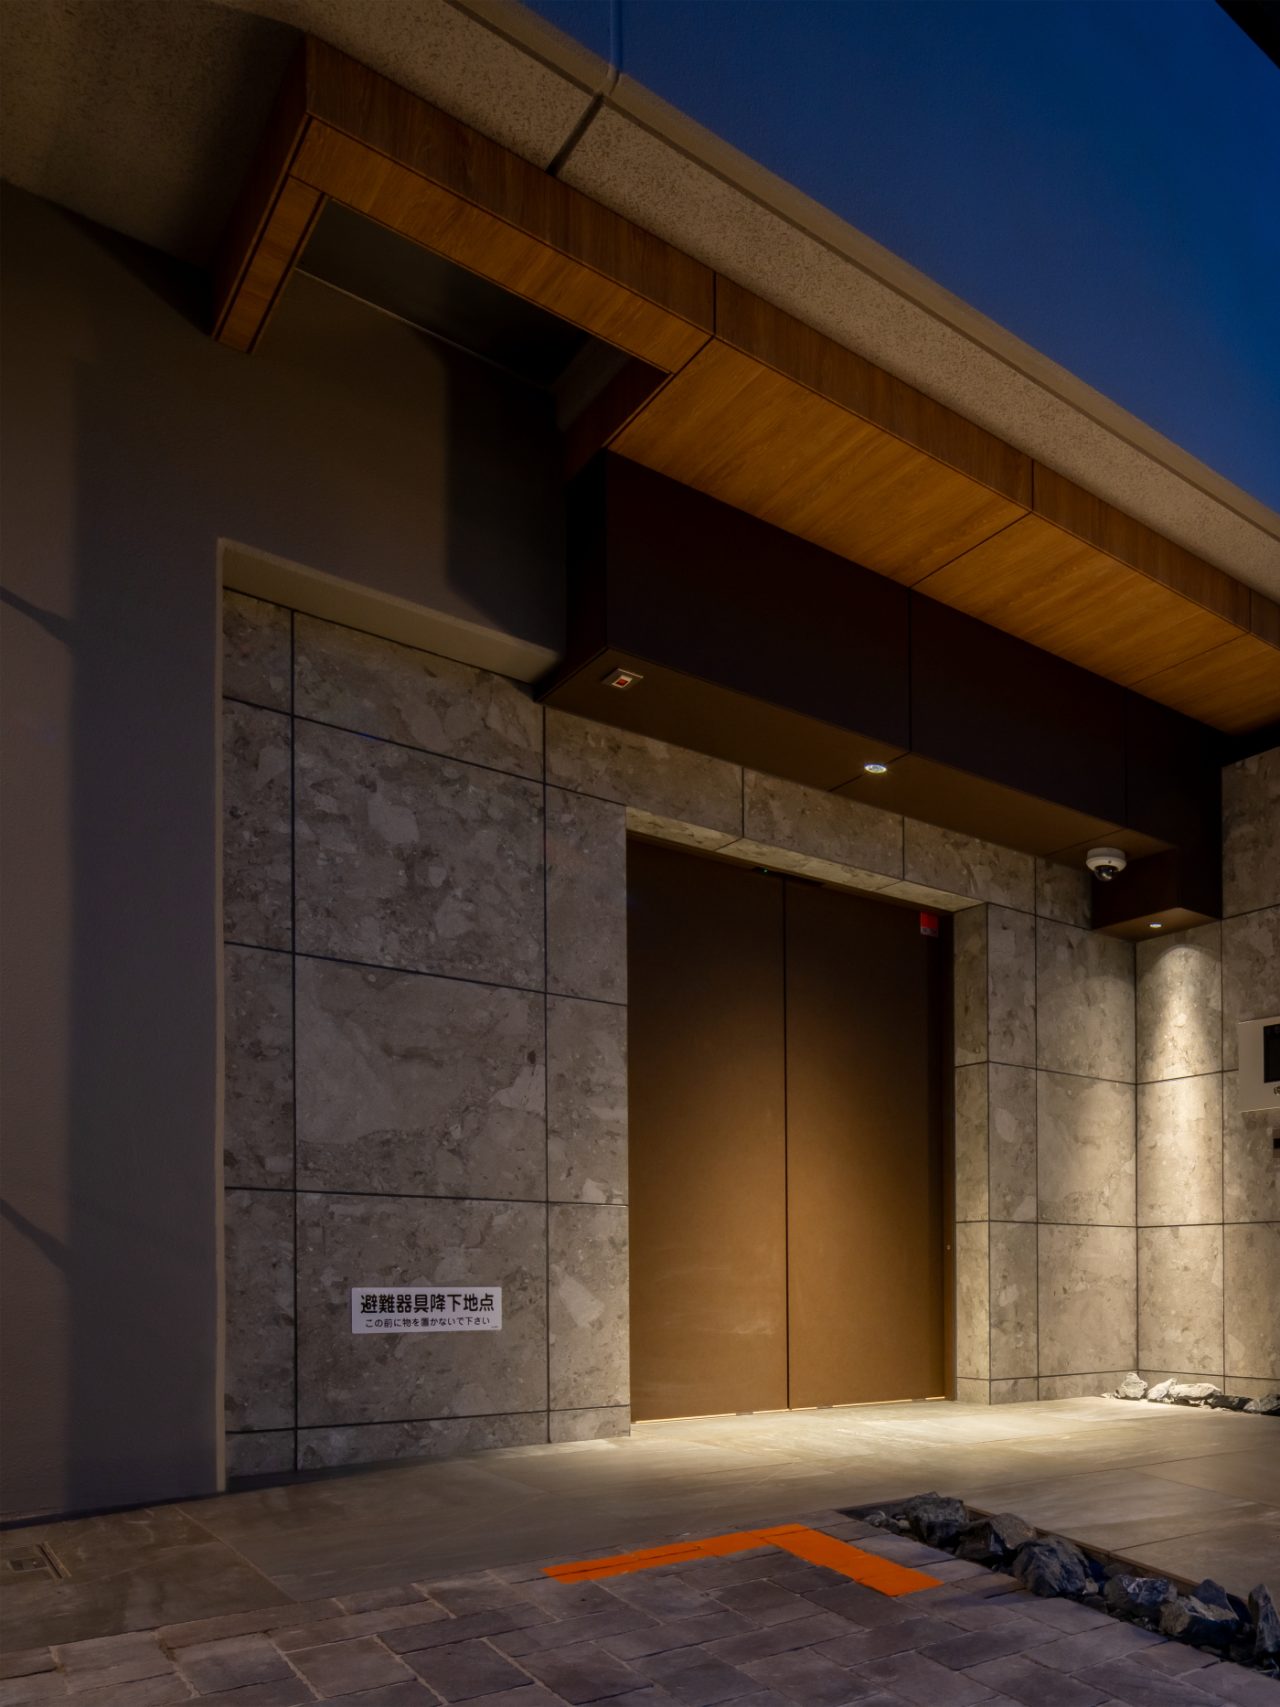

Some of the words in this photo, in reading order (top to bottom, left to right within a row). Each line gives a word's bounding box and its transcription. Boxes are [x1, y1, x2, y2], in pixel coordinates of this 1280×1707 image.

[360, 1293, 495, 1314] 避難器具降下地点
[365, 1316, 490, 1328] この前に物を置かないで下さい
